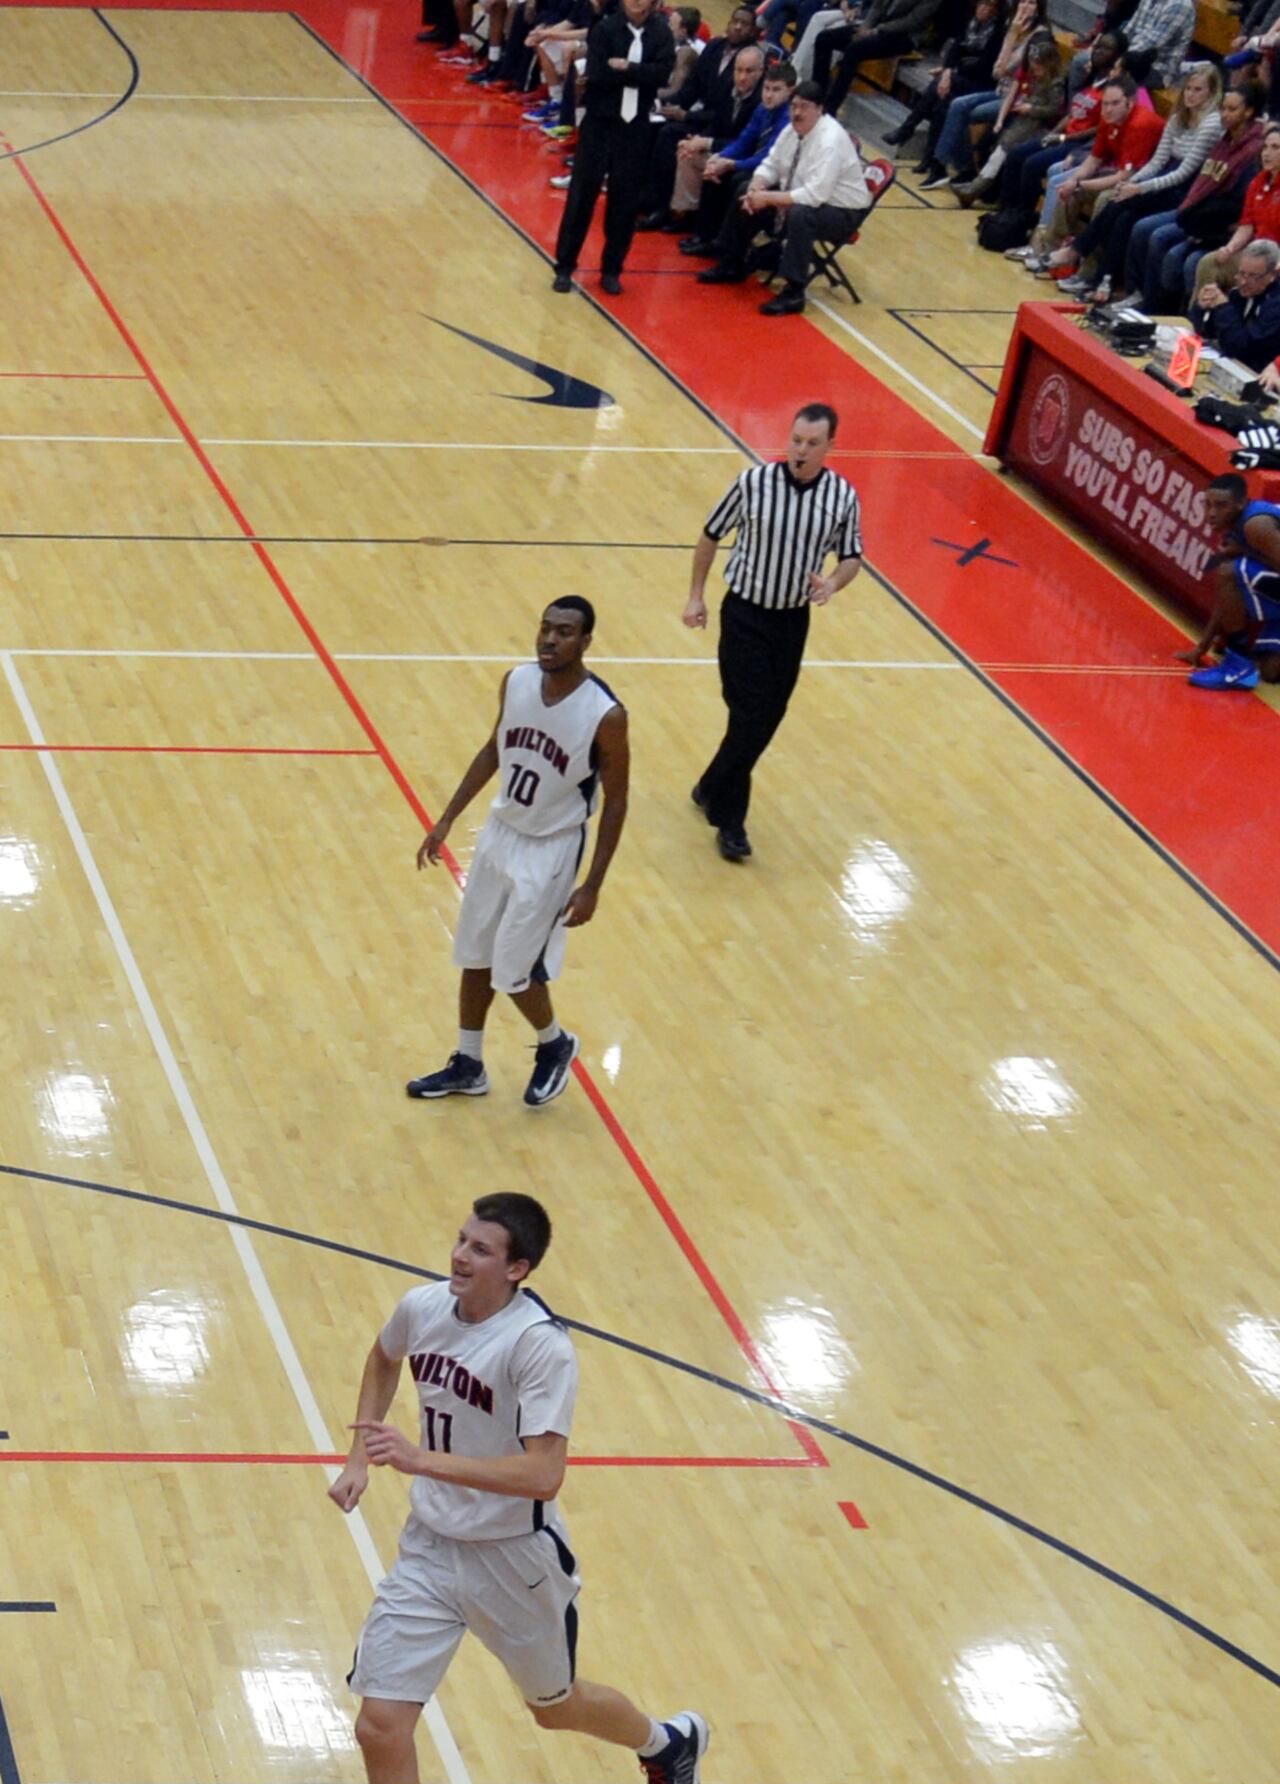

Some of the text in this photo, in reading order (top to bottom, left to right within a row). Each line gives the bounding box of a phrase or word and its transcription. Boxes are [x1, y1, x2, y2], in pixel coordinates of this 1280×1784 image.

[1077, 408, 1136, 473] SUBS
[1131, 450, 1166, 494] SO
[1161, 471, 1212, 537] FAS
[1063, 442, 1213, 582] YOU'LL FREAK!
[503, 726, 571, 777] MILTON
[507, 763, 541, 807] 10
[424, 1406, 453, 1454] 11
